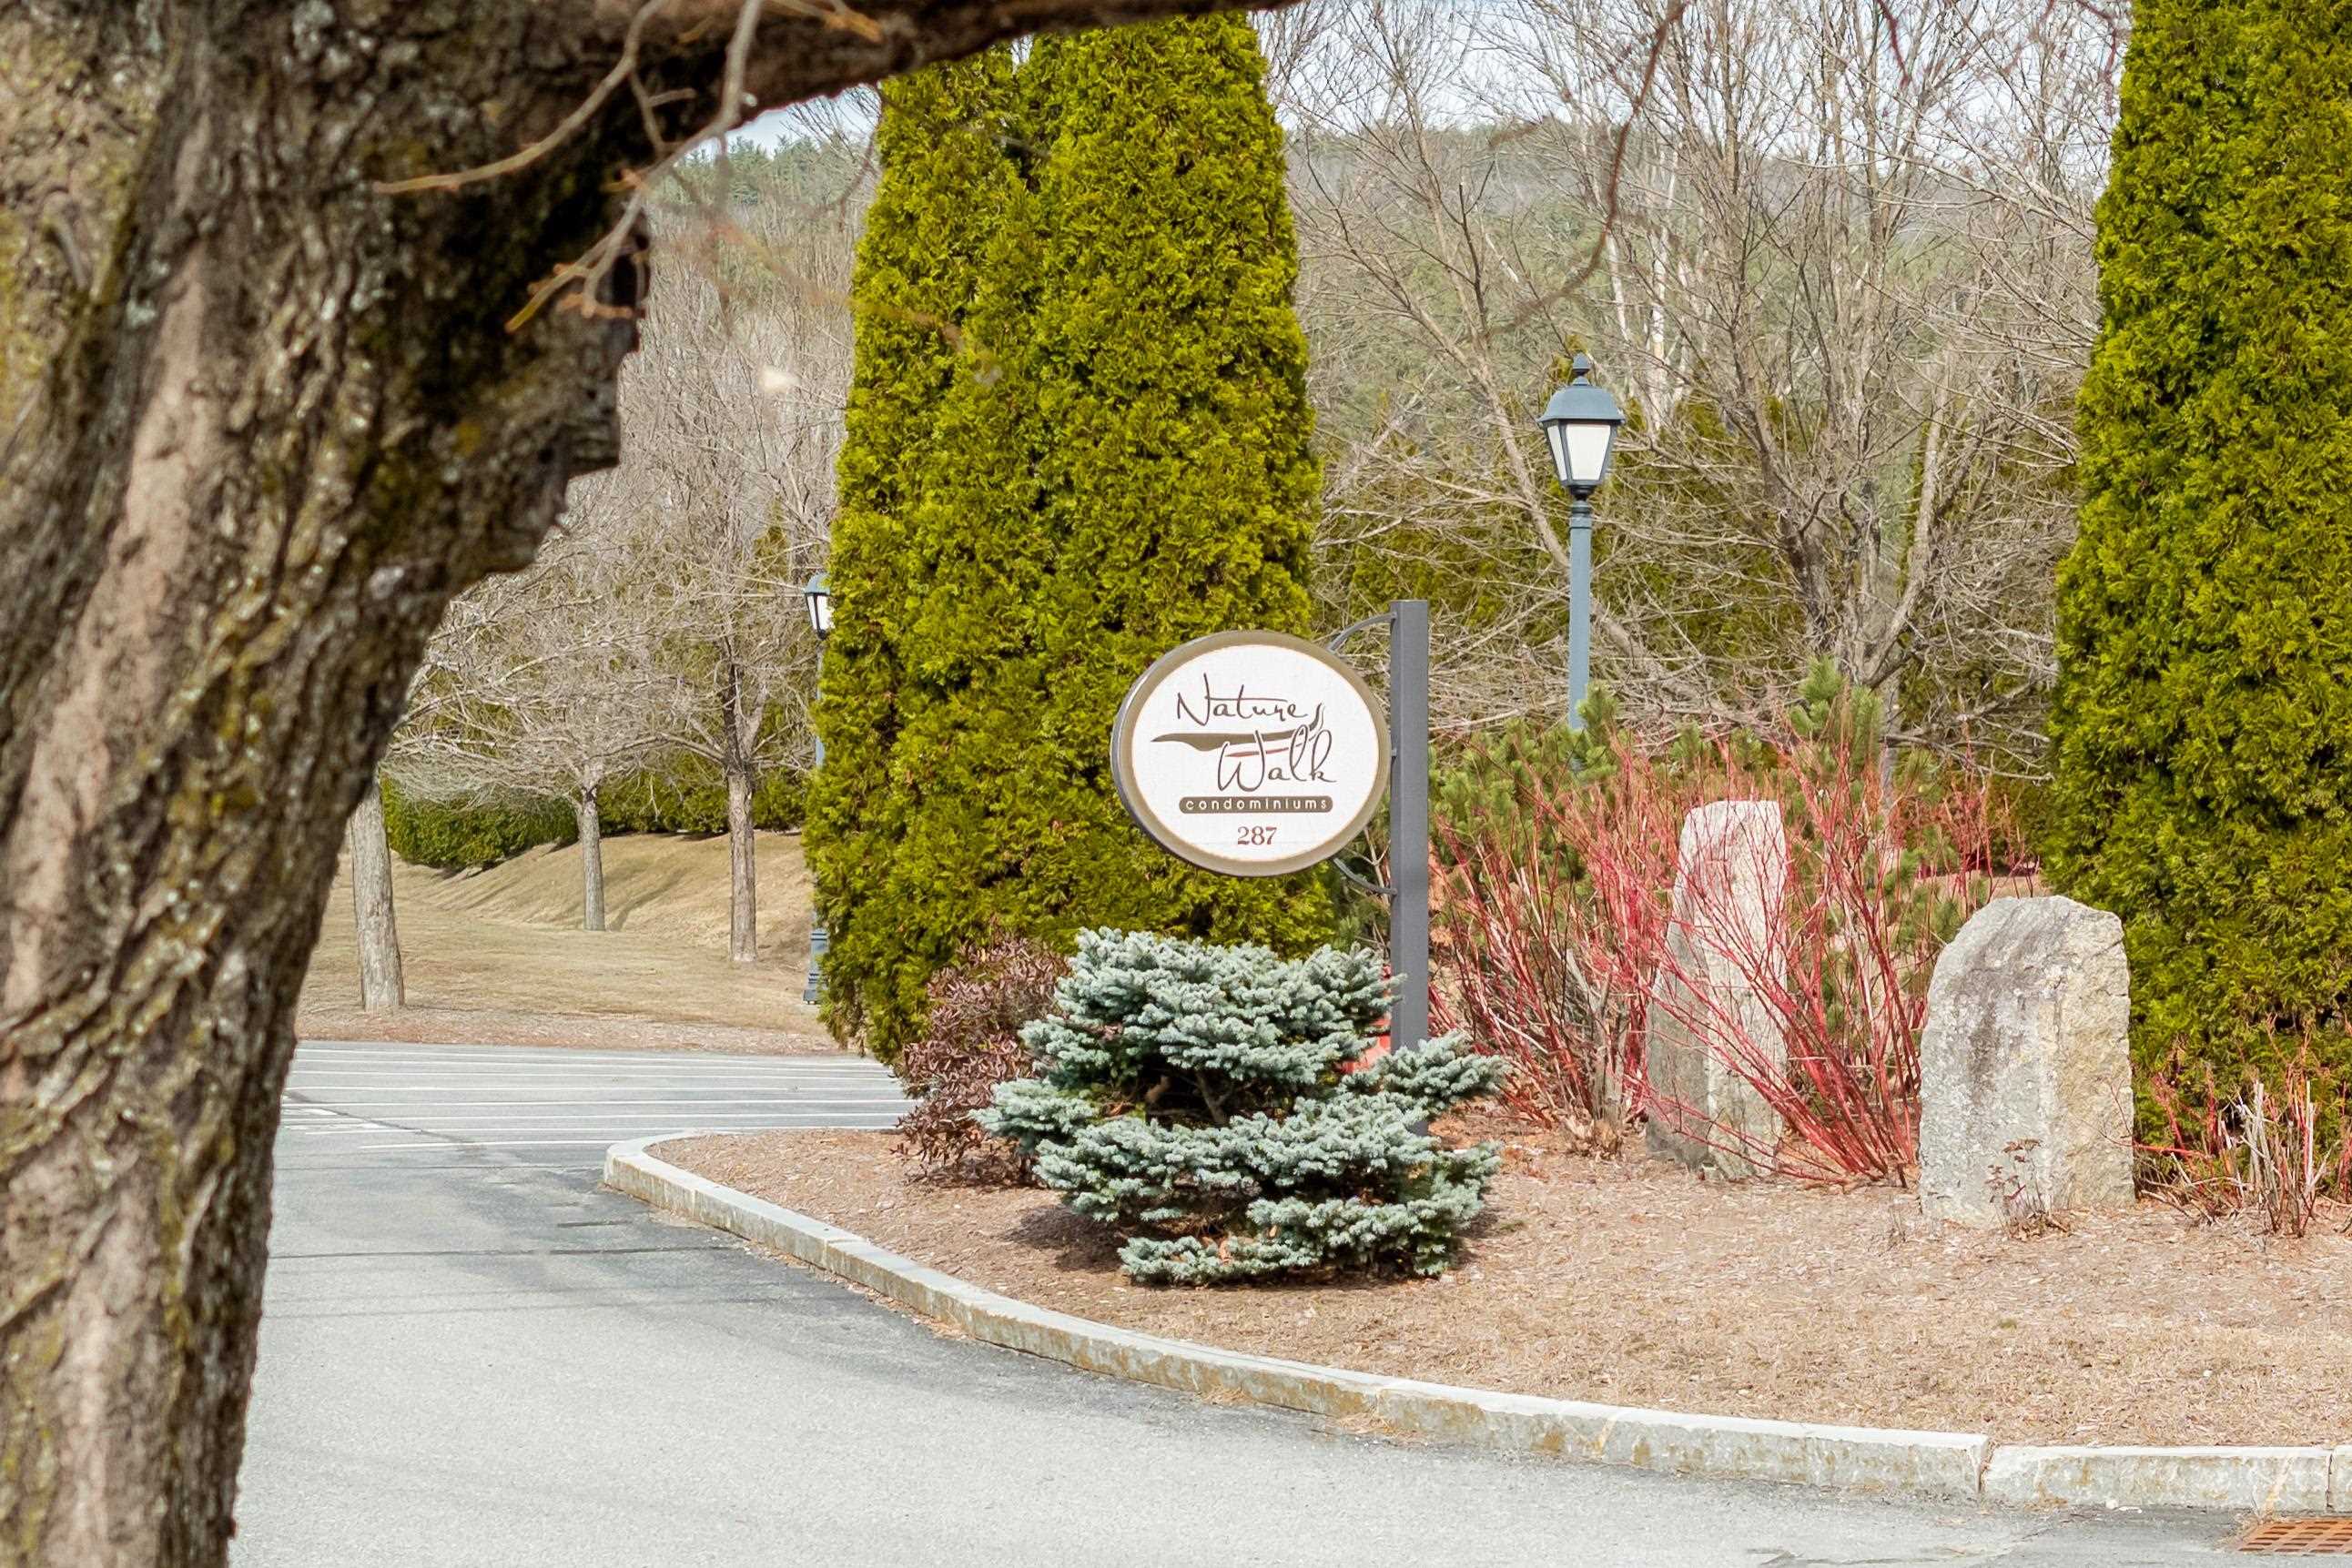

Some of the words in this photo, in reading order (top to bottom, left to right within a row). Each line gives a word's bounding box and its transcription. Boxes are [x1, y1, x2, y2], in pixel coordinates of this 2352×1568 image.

[1176, 673, 1308, 726] Nature
[1217, 724, 1336, 792] Walk
[1185, 796, 1328, 810] condominiums
[1237, 826, 1278, 846] 287
